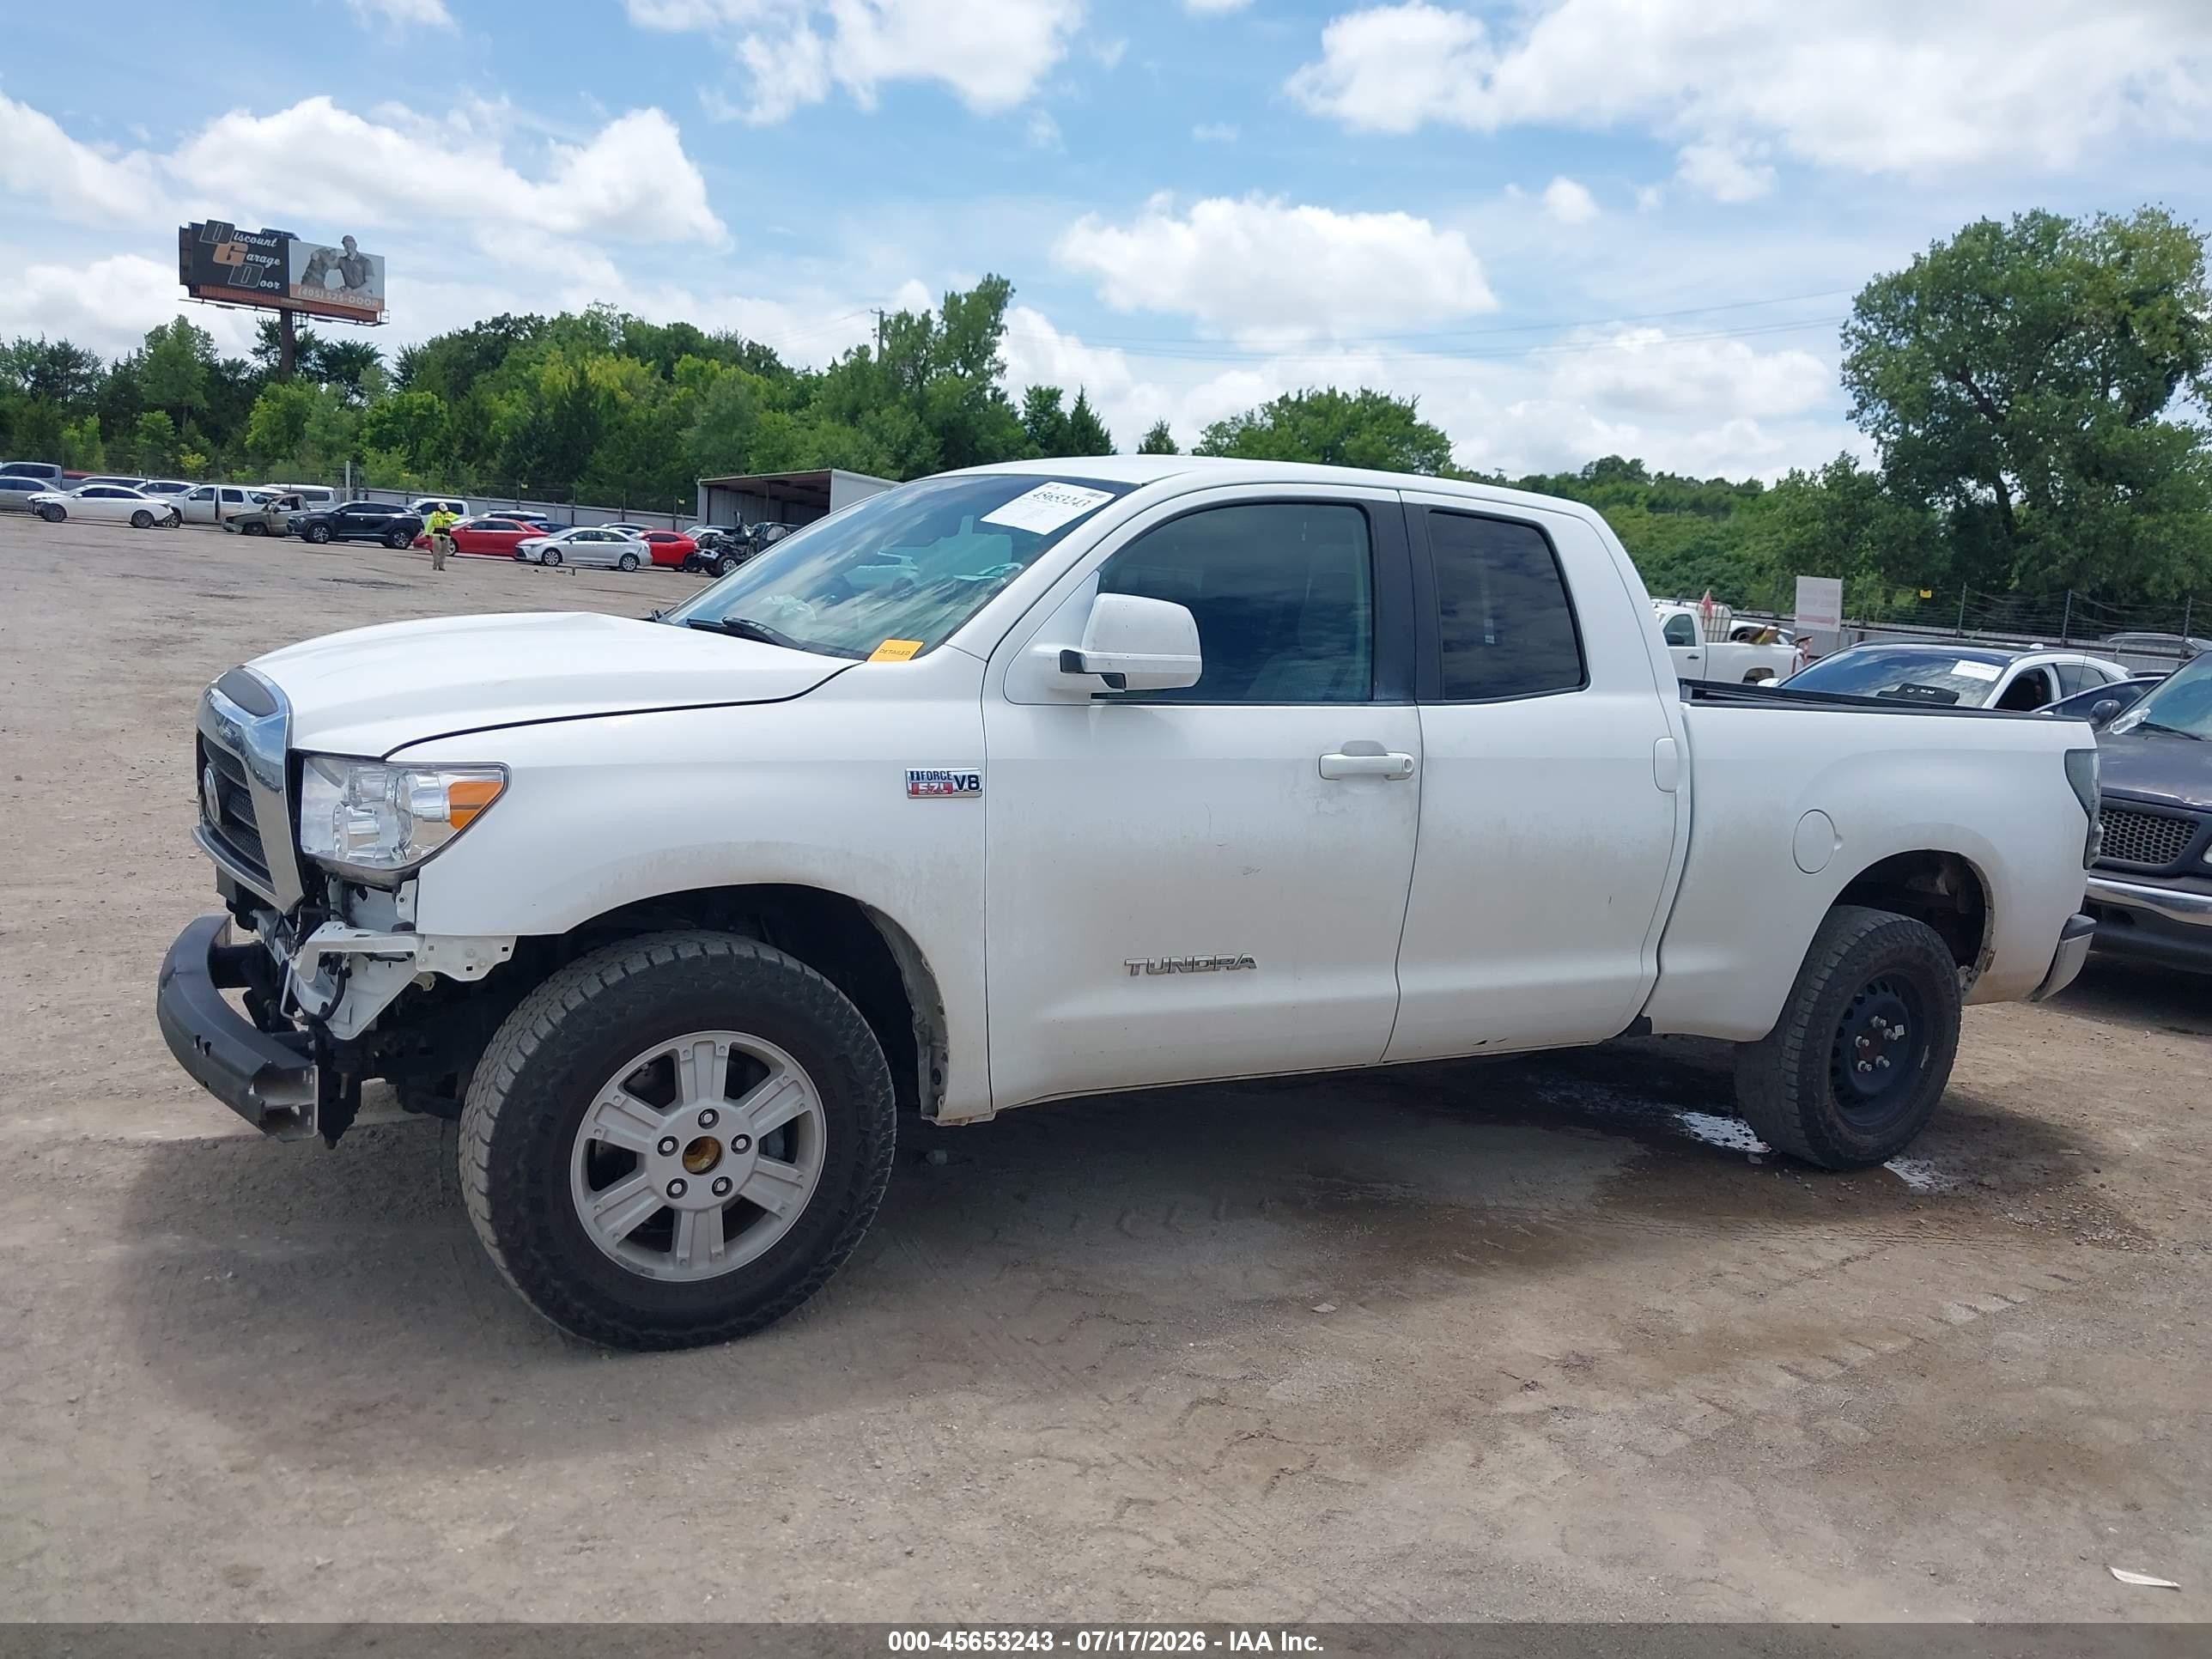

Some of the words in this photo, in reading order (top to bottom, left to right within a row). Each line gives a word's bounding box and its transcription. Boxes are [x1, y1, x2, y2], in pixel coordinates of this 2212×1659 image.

[199, 219, 277, 248] Discount
[212, 241, 282, 269] Garage
[228, 263, 282, 289] Door
[953, 775, 980, 791] V8
[1125, 952, 1257, 976] TUNDRA
